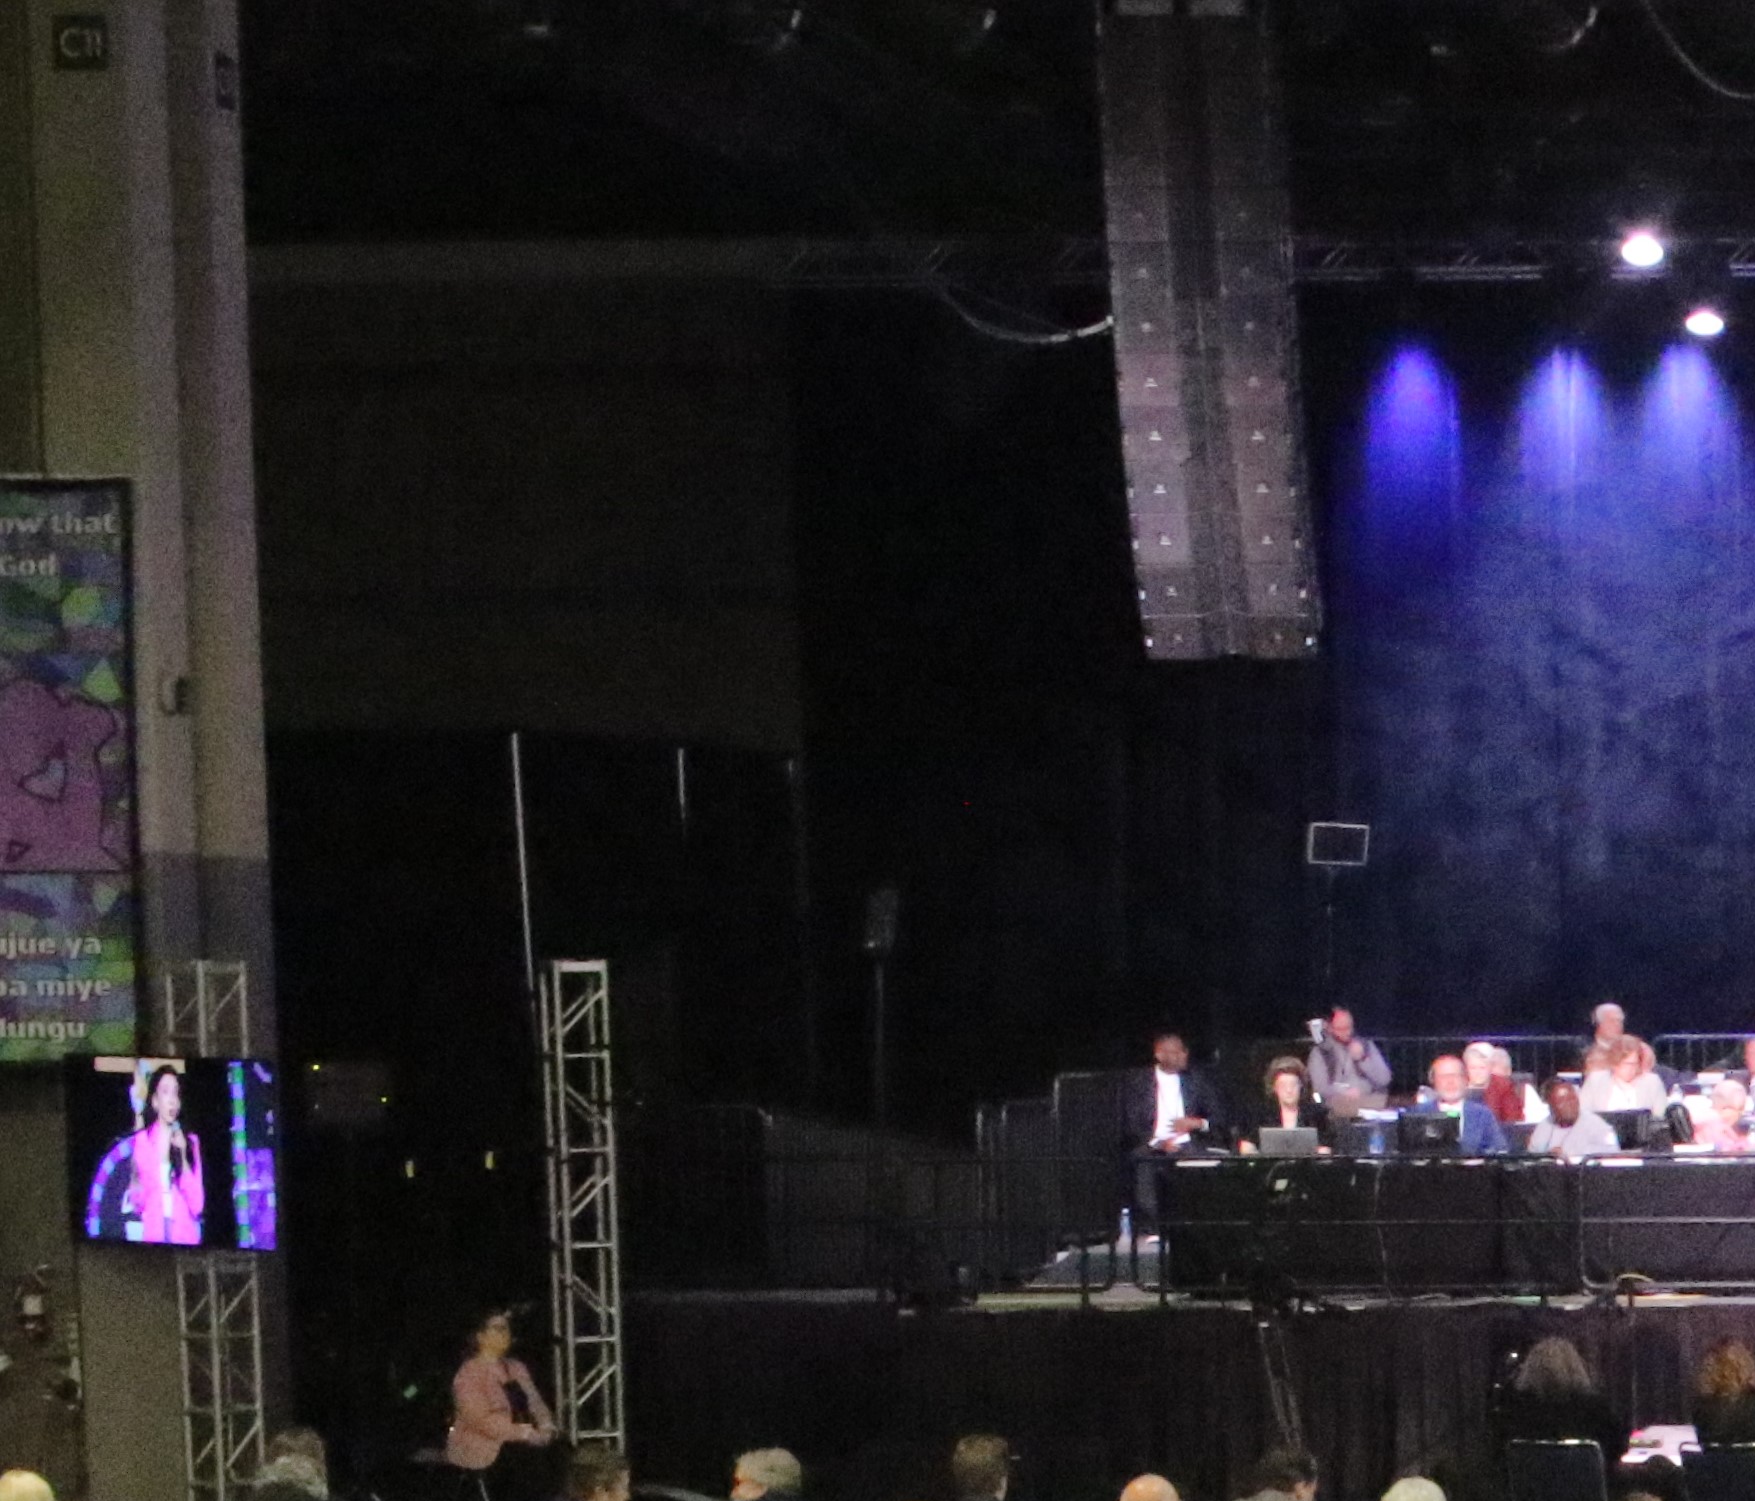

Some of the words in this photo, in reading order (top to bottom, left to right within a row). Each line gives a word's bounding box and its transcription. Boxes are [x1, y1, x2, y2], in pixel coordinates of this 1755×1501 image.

[50, 511, 117, 534] that
[64, 937, 102, 960] ya
[36, 974, 112, 1002] miye
